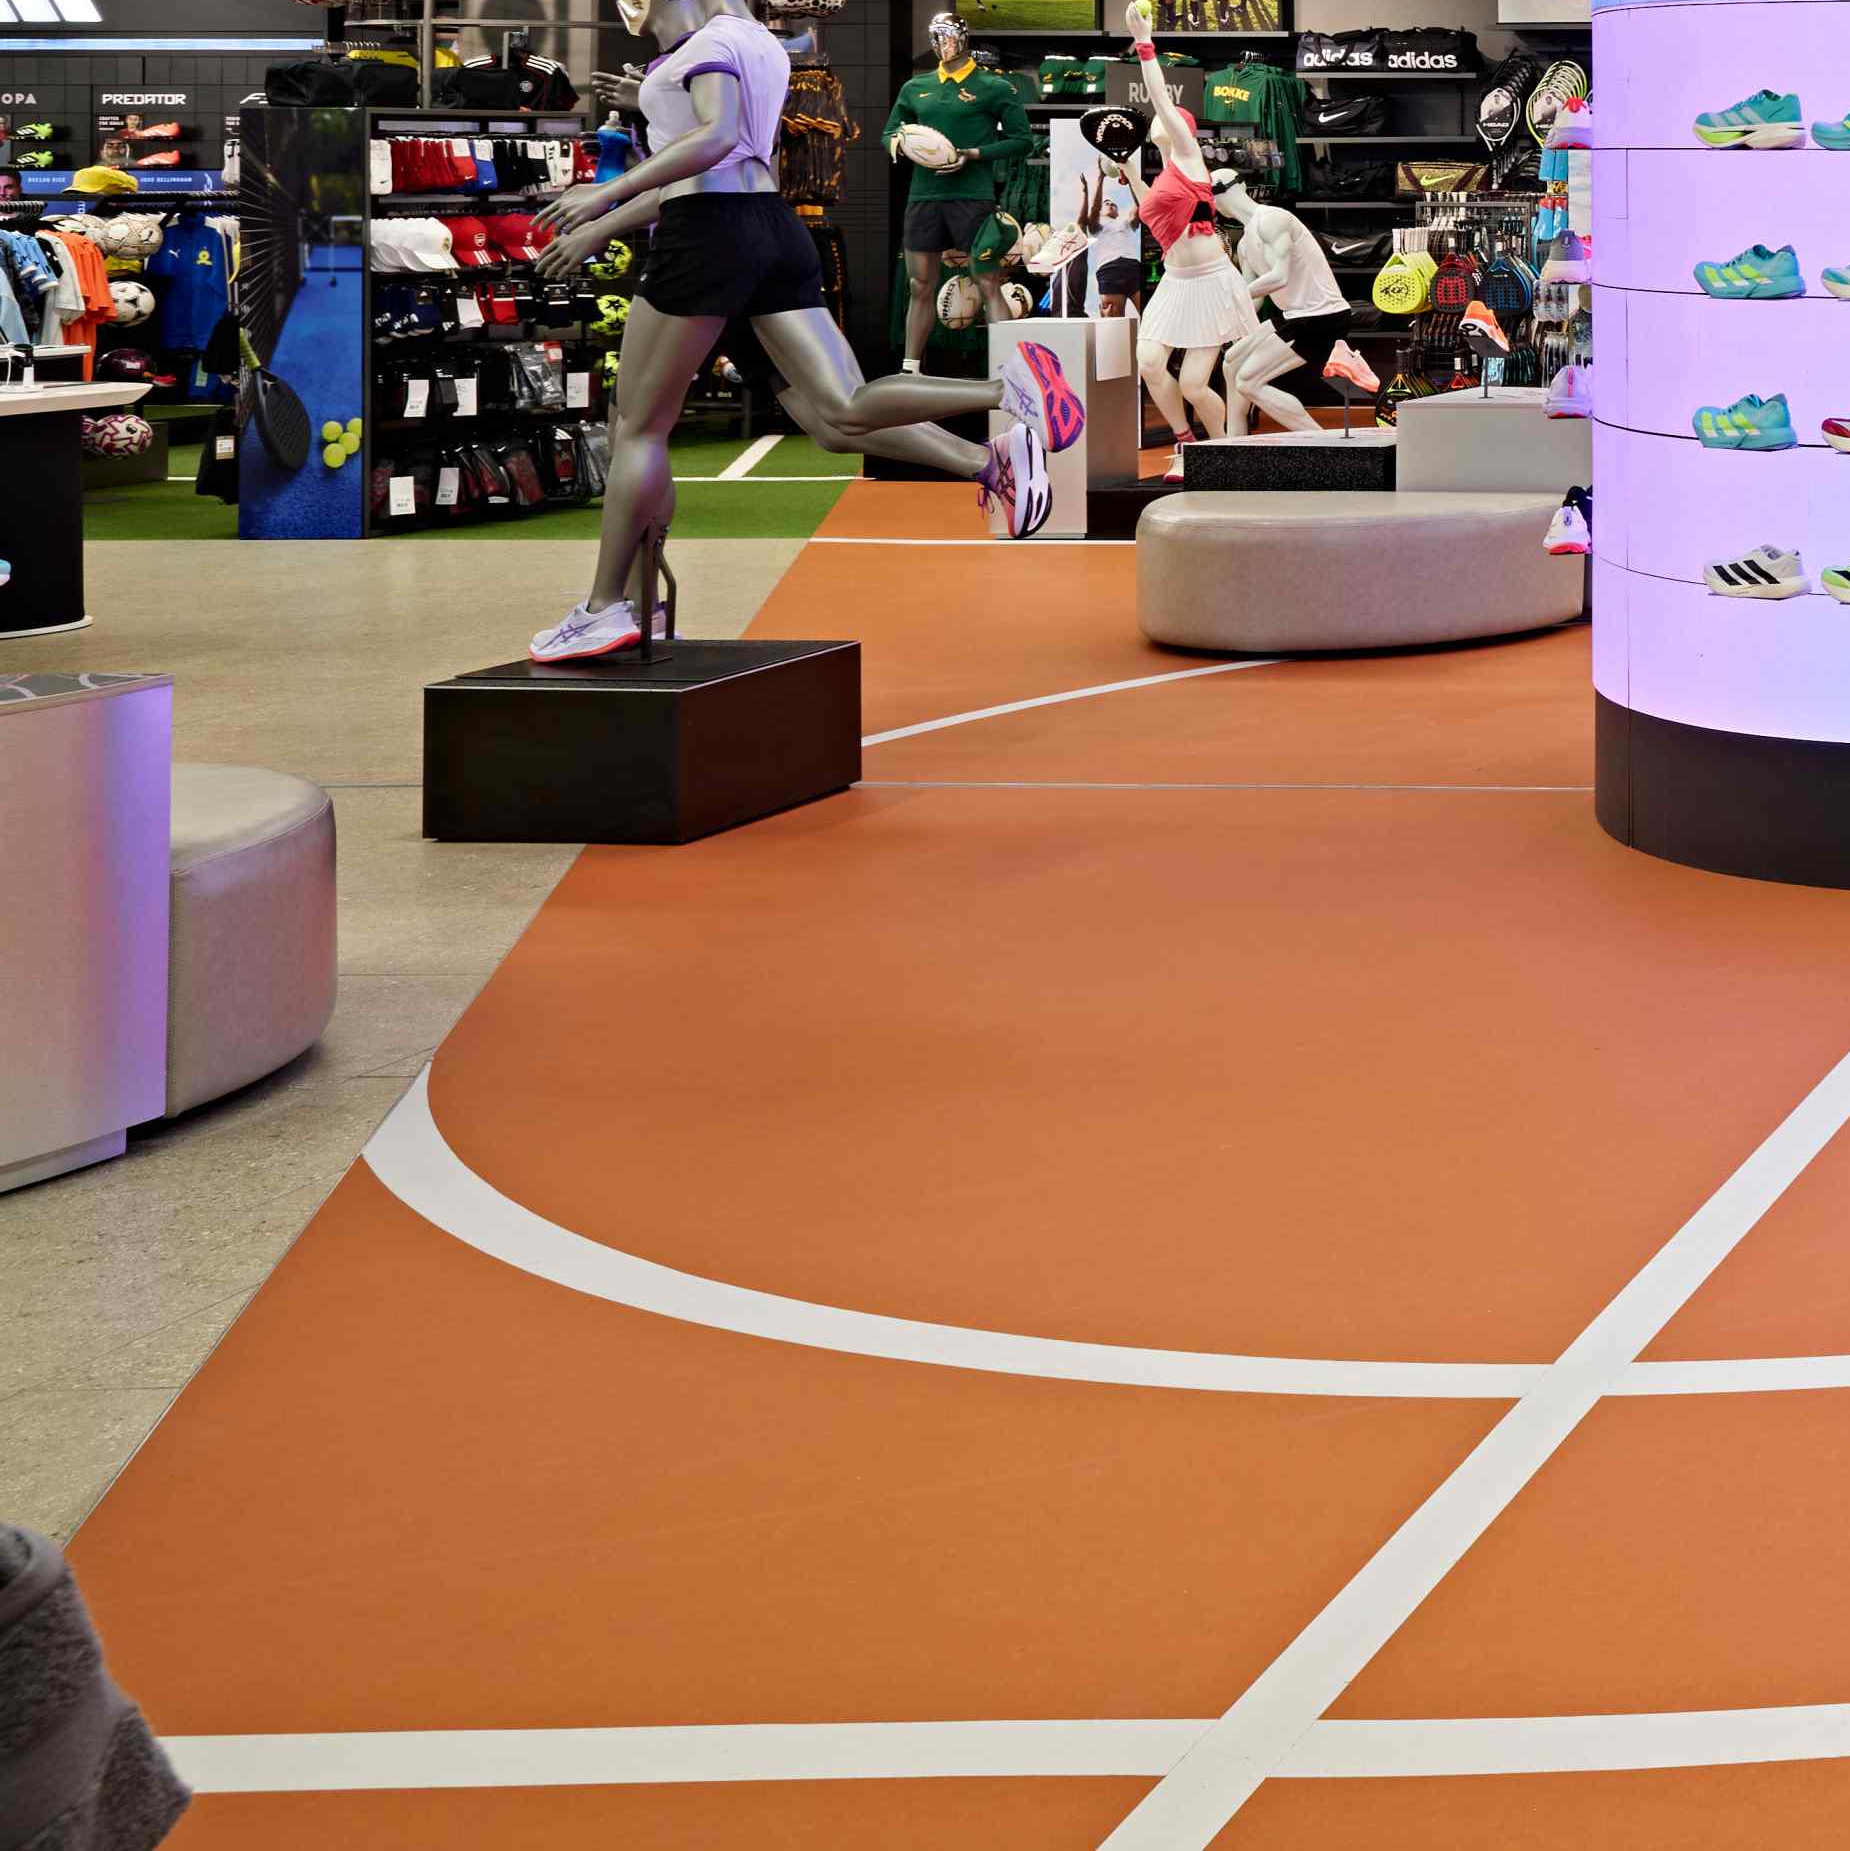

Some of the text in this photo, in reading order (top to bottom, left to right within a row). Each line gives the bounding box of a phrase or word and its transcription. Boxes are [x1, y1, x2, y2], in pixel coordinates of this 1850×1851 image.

[1303, 48, 1373, 67] adidas
[1387, 51, 1458, 69] adidas
[102, 93, 187, 105] PREDATOR
[1128, 82, 1184, 104] RUBY
